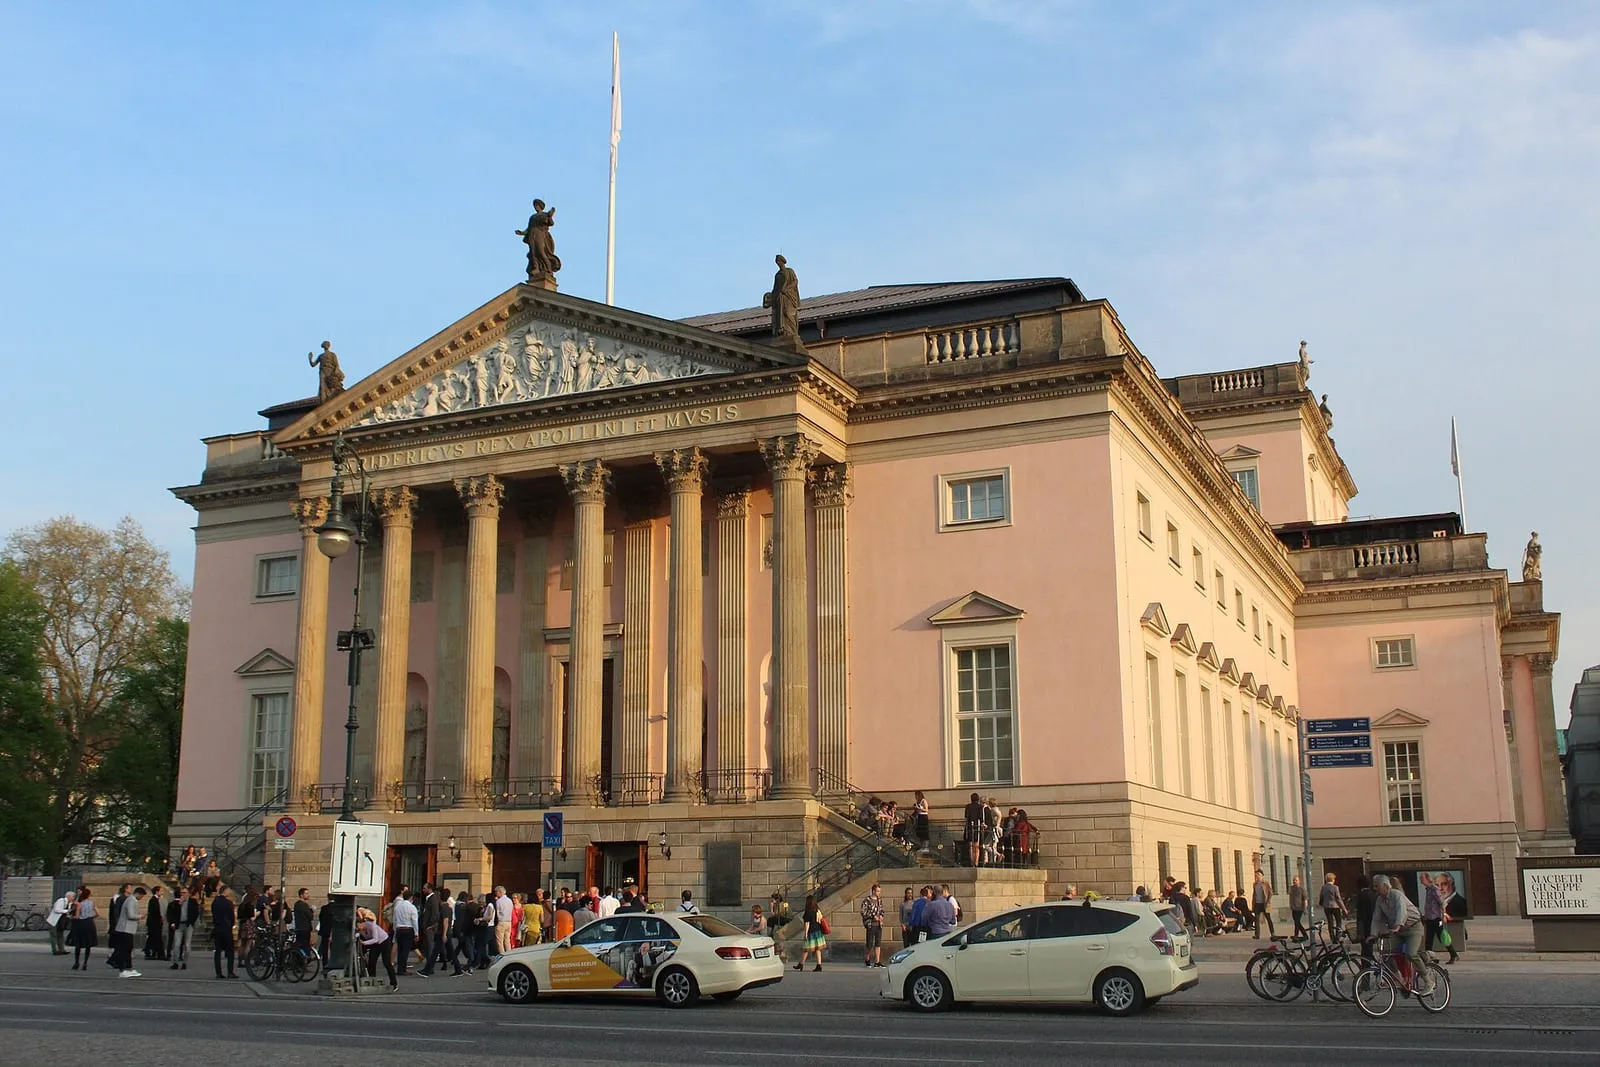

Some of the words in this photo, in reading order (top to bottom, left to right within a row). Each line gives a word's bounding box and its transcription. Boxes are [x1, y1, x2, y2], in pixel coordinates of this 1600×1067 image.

[474, 435, 520, 455] REX
[524, 420, 626, 448] APOLLINI
[634, 418, 657, 433] ET
[665, 404, 740, 429] MVSIS
[545, 836, 561, 845] TAXI
[1531, 874, 1583, 884] MACBETH
[1531, 883, 1583, 892] GIUSEPPE
[1532, 891, 1565, 900] VERDI
[1533, 899, 1589, 909] PREMIERE
